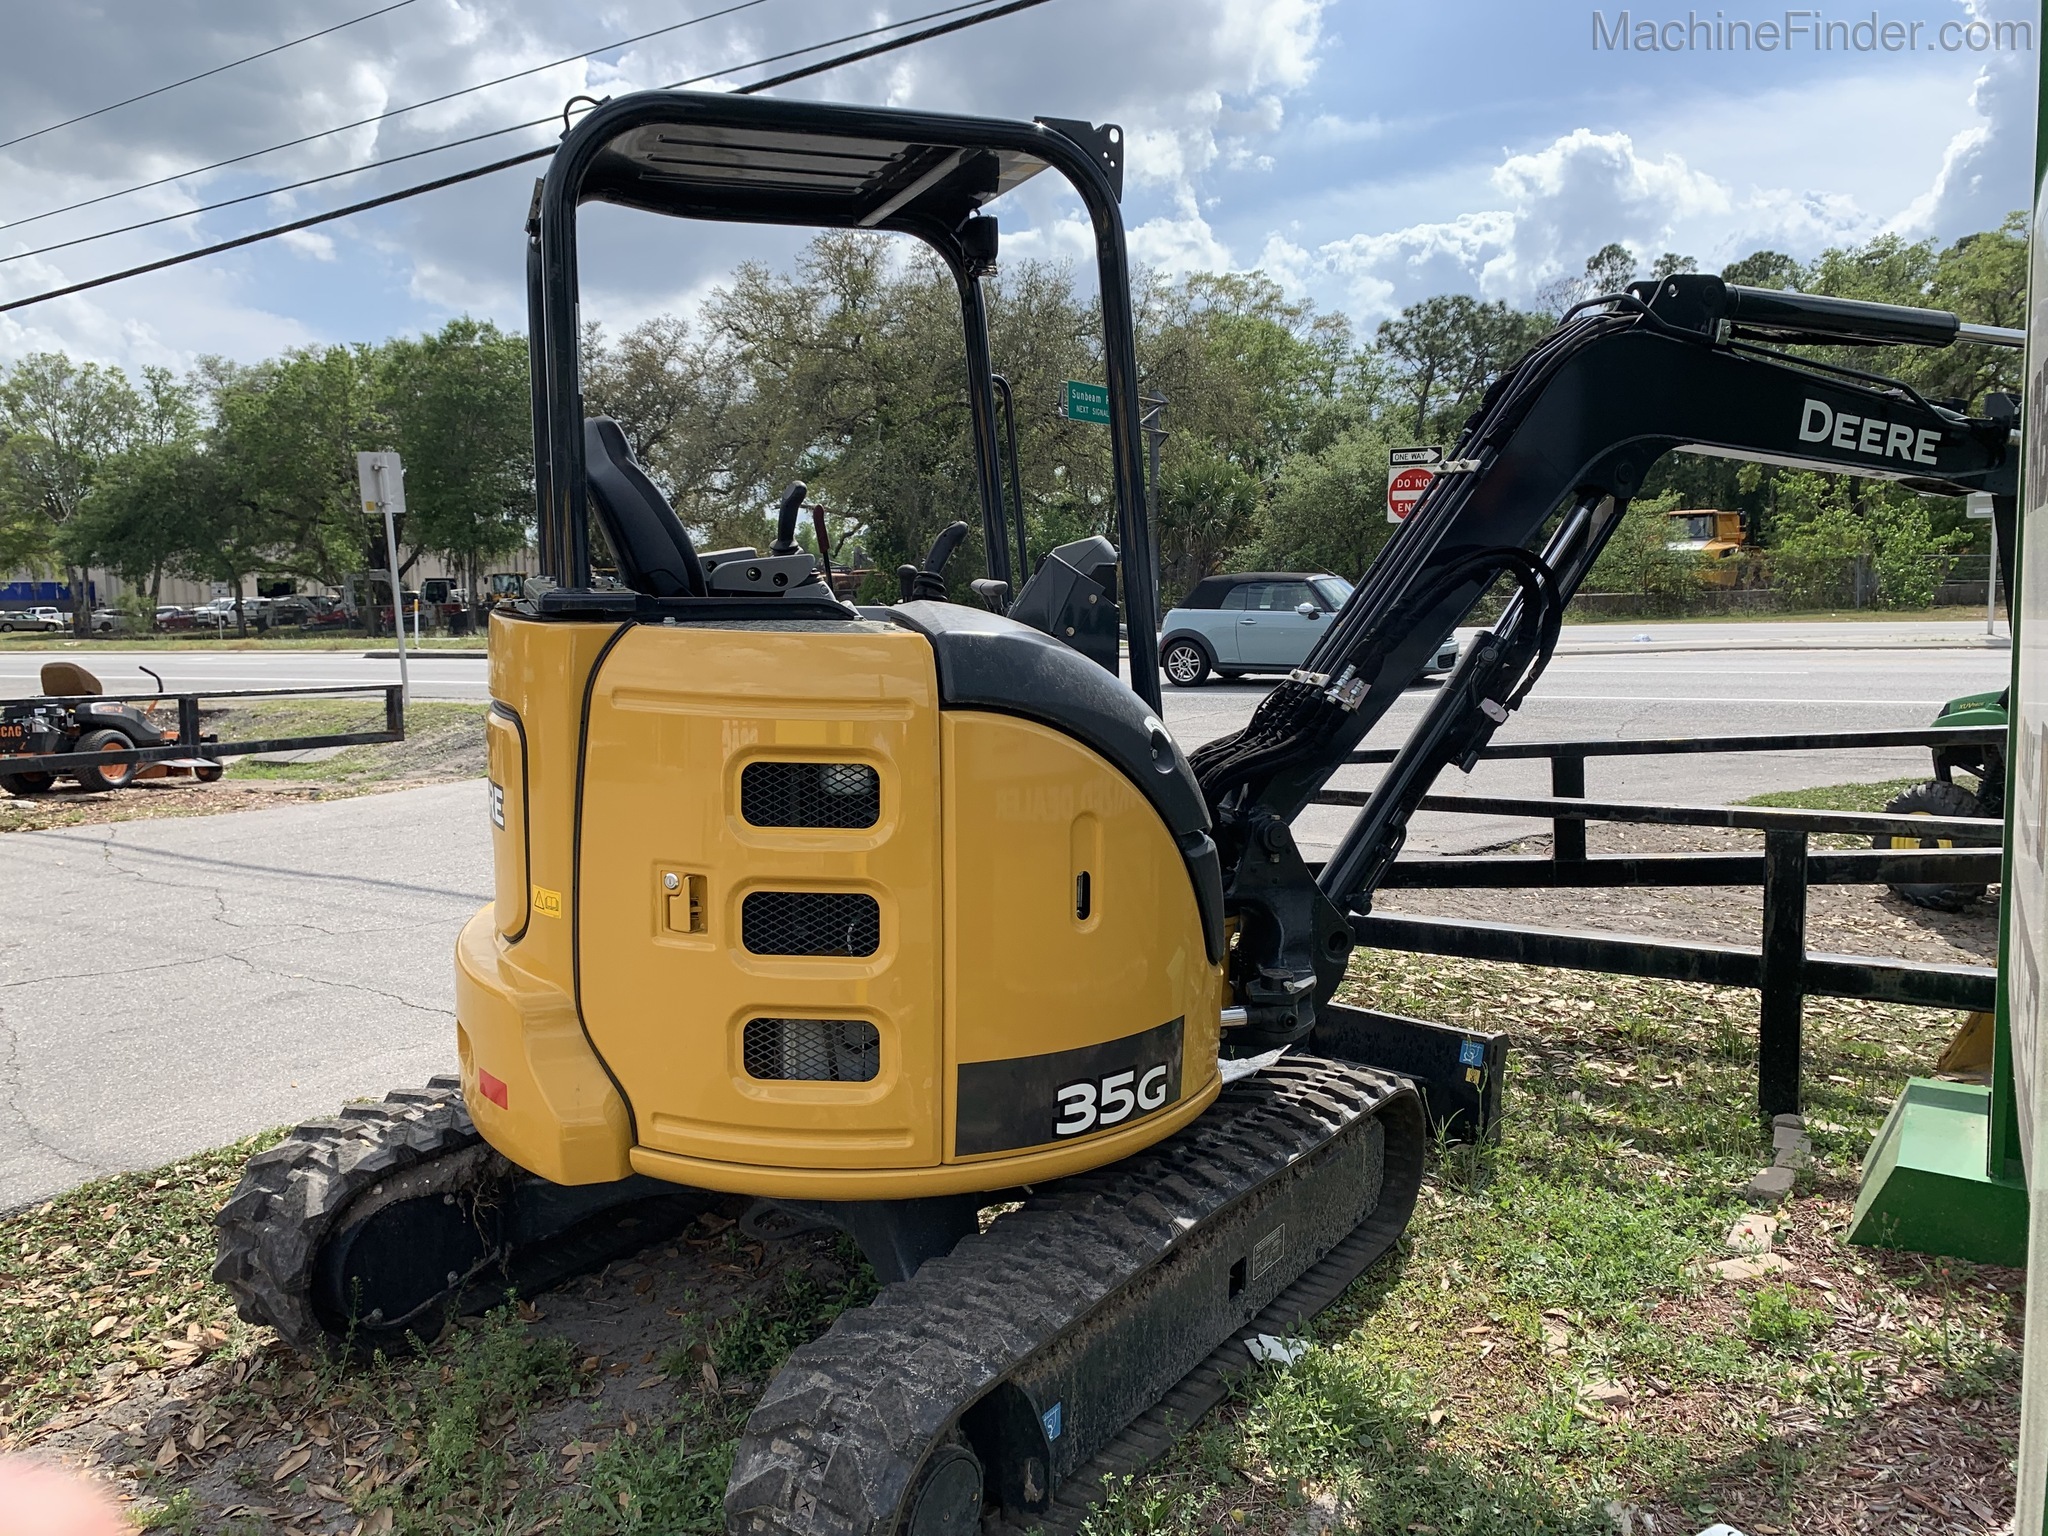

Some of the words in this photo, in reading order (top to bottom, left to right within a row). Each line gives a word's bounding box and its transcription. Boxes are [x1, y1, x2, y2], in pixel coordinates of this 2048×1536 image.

[1072, 389, 1102, 404] Sunbeam
[1076, 404, 1089, 414] NEXT
[1798, 398, 1942, 465] DEERE
[1394, 453, 1409, 461] ONE
[1411, 452, 1426, 460] WAY
[1397, 479, 1411, 488] DO
[1415, 478, 1432, 488] NO
[1398, 503, 1415, 512] EN
[0, 725, 22, 738] CAG
[1056, 1065, 1167, 1135] 35G
